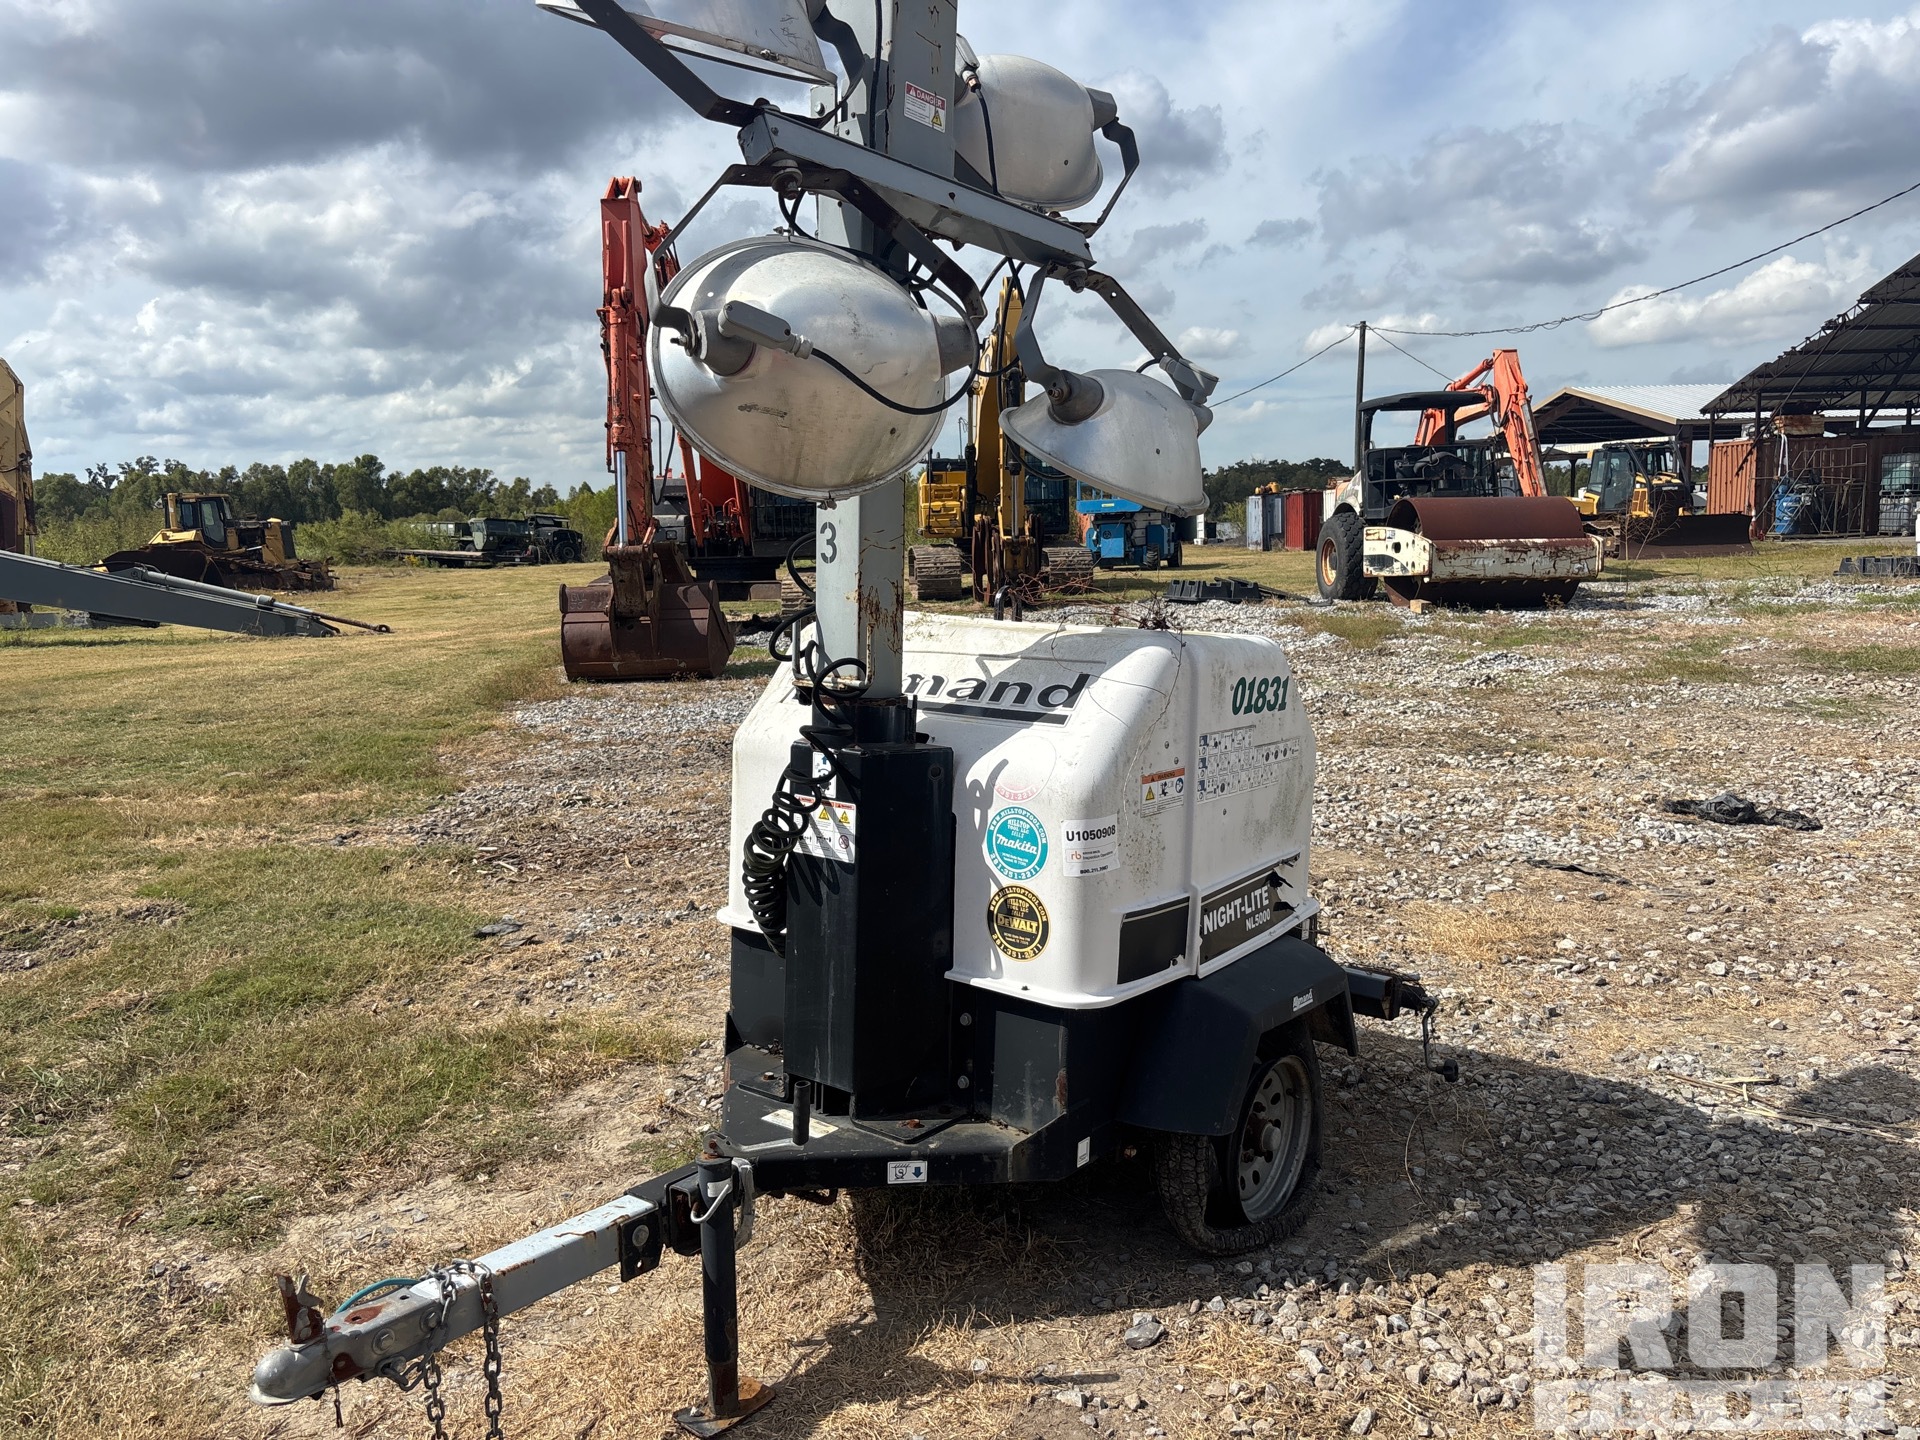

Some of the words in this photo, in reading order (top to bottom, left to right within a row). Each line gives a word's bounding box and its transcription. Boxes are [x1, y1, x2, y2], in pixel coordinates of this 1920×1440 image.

[916, 90, 943, 108] DANGER
[820, 521, 838, 564] 3
[902, 673, 1091, 710] mand
[1231, 675, 1290, 716] 01831
[1066, 824, 1116, 842] U1050908
[1203, 884, 1270, 935] NIGHT-LITE
[1245, 908, 1271, 932] NL5000
